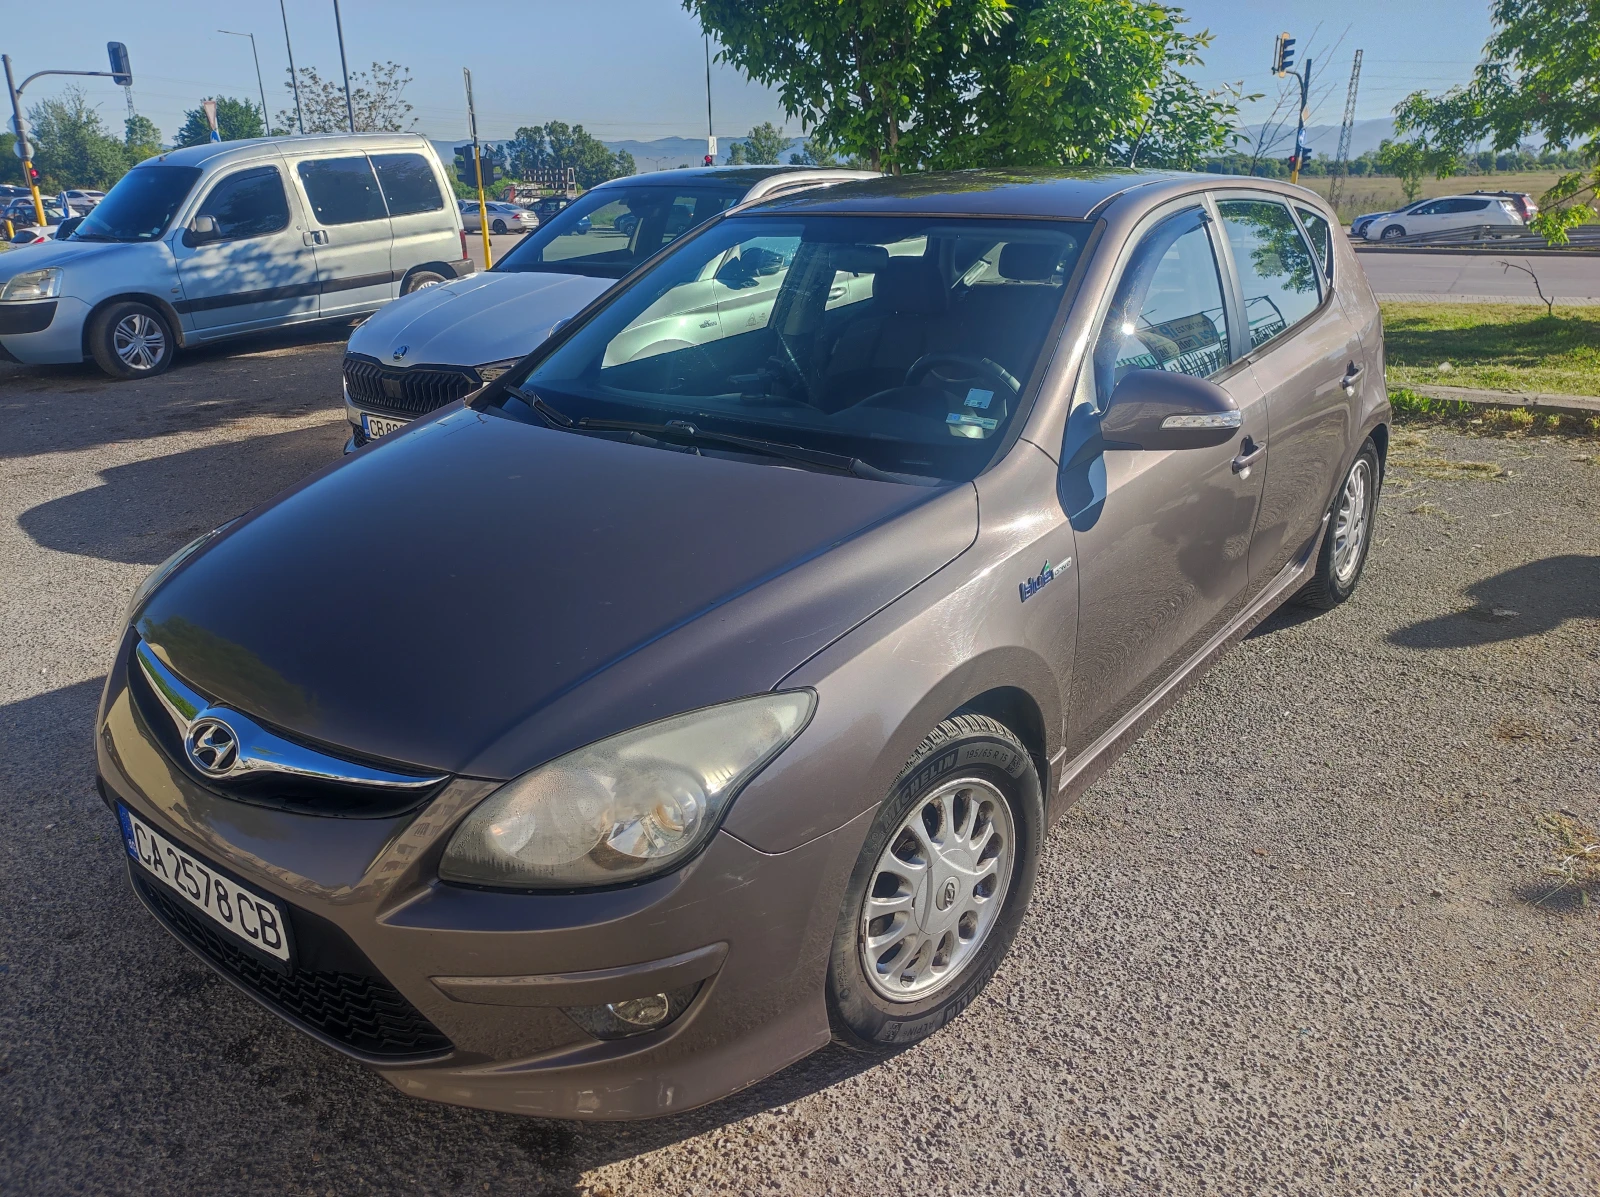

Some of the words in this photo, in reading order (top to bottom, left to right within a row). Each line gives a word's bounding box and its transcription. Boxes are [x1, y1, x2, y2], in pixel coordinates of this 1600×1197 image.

[370, 419, 385, 437] CB
[1019, 563, 1054, 603] blue
[966, 748, 993, 760] 195/65
[993, 750, 1000, 759] R
[1000, 753, 1009, 762] 15
[882, 752, 956, 830] MICHELIN
[134, 822, 169, 879] CA
[167, 847, 234, 923] 2578
[236, 892, 282, 950] CB
